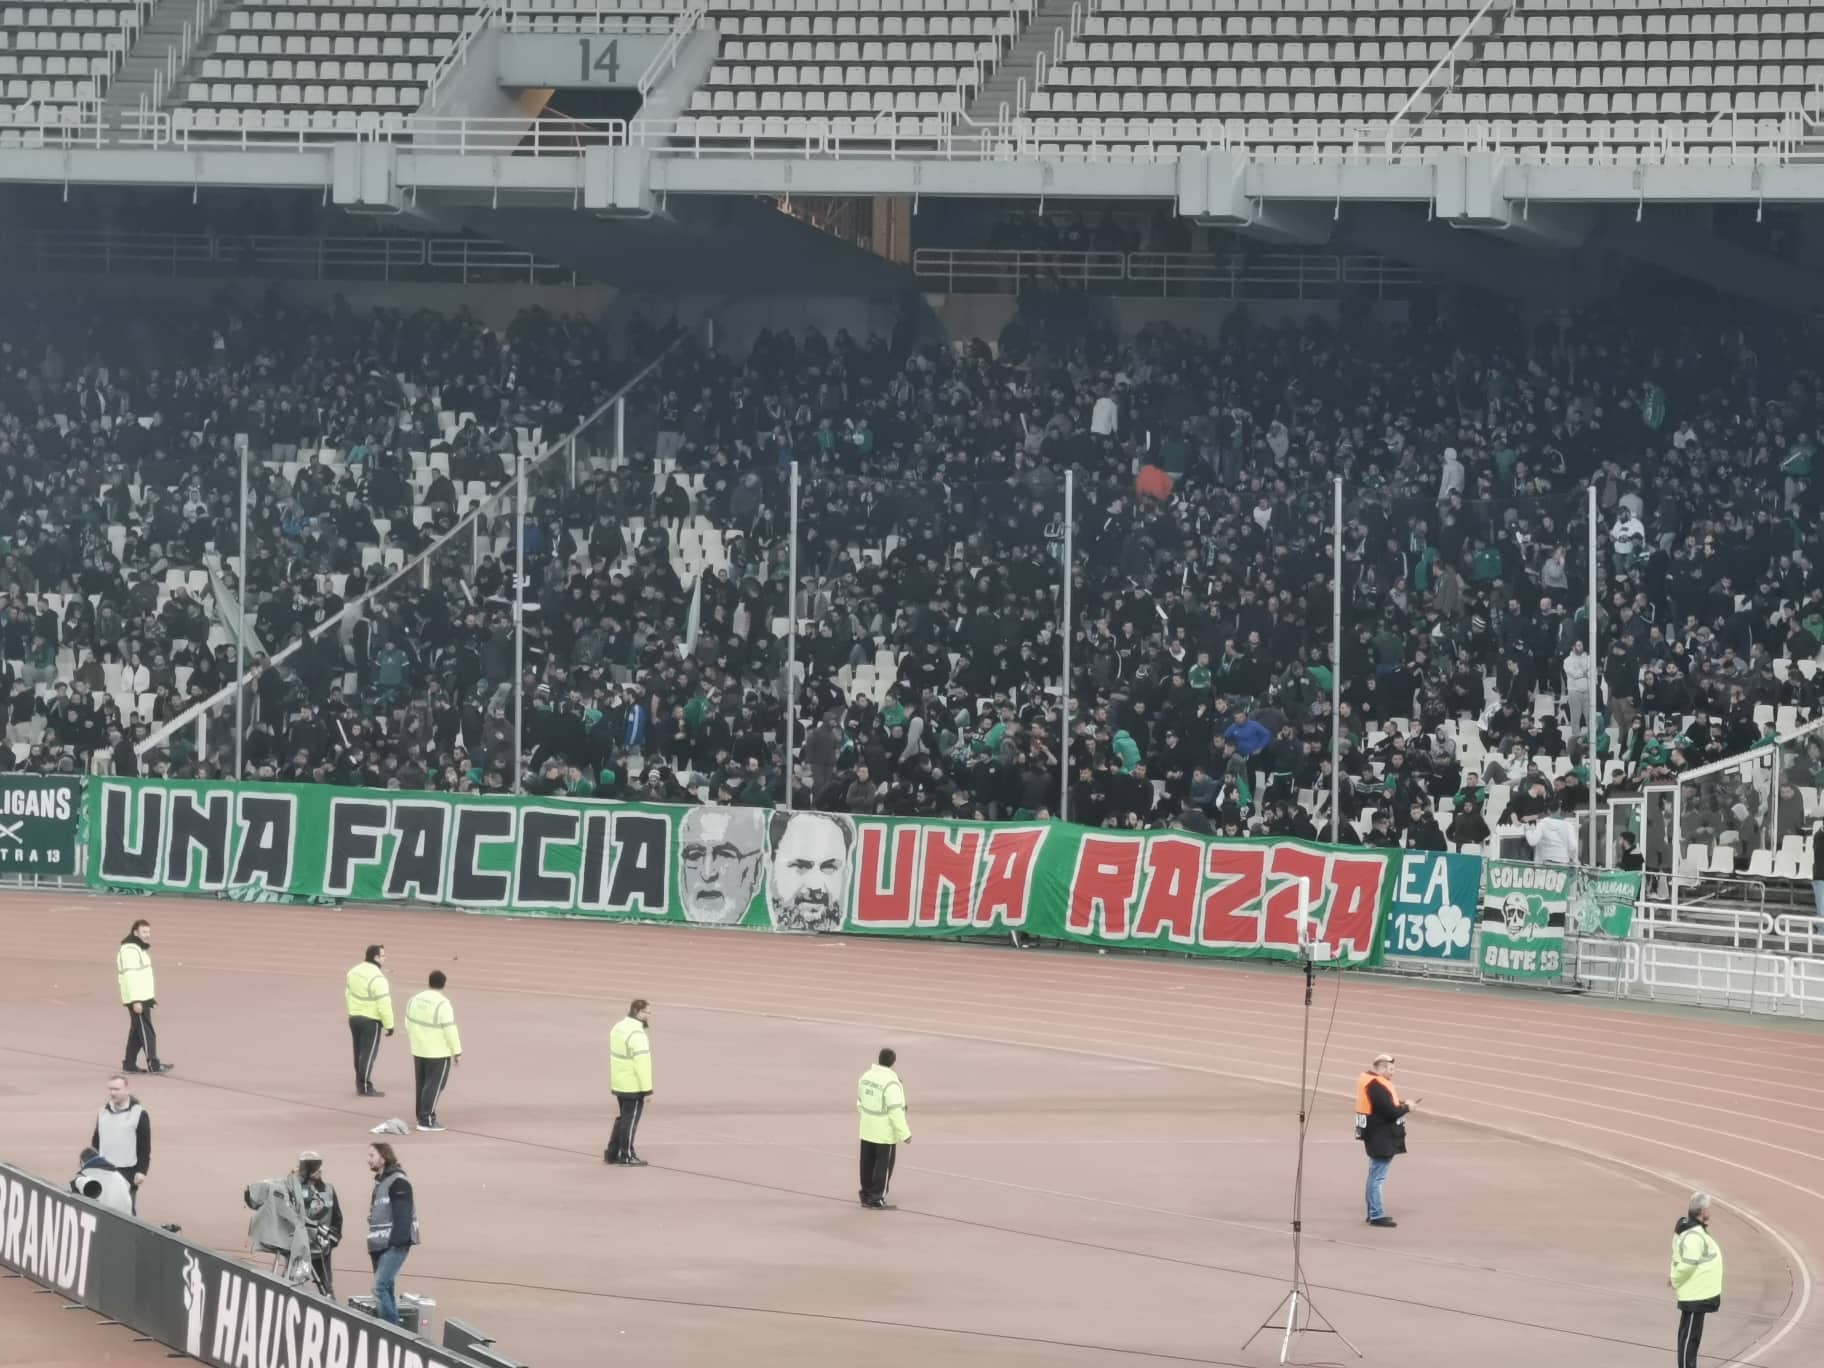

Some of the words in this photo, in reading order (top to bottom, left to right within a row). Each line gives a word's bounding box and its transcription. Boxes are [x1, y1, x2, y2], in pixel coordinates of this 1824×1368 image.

[579, 38, 620, 83] 14
[0, 787, 72, 820] IGANS
[46, 849, 60, 863] 13
[99, 782, 298, 892] UNA
[323, 798, 672, 915] FACCIA
[851, 822, 1049, 927] UNA
[1065, 834, 1389, 961] RAZZA
[1391, 854, 1450, 906] EA
[1484, 945, 1537, 972] GATE
